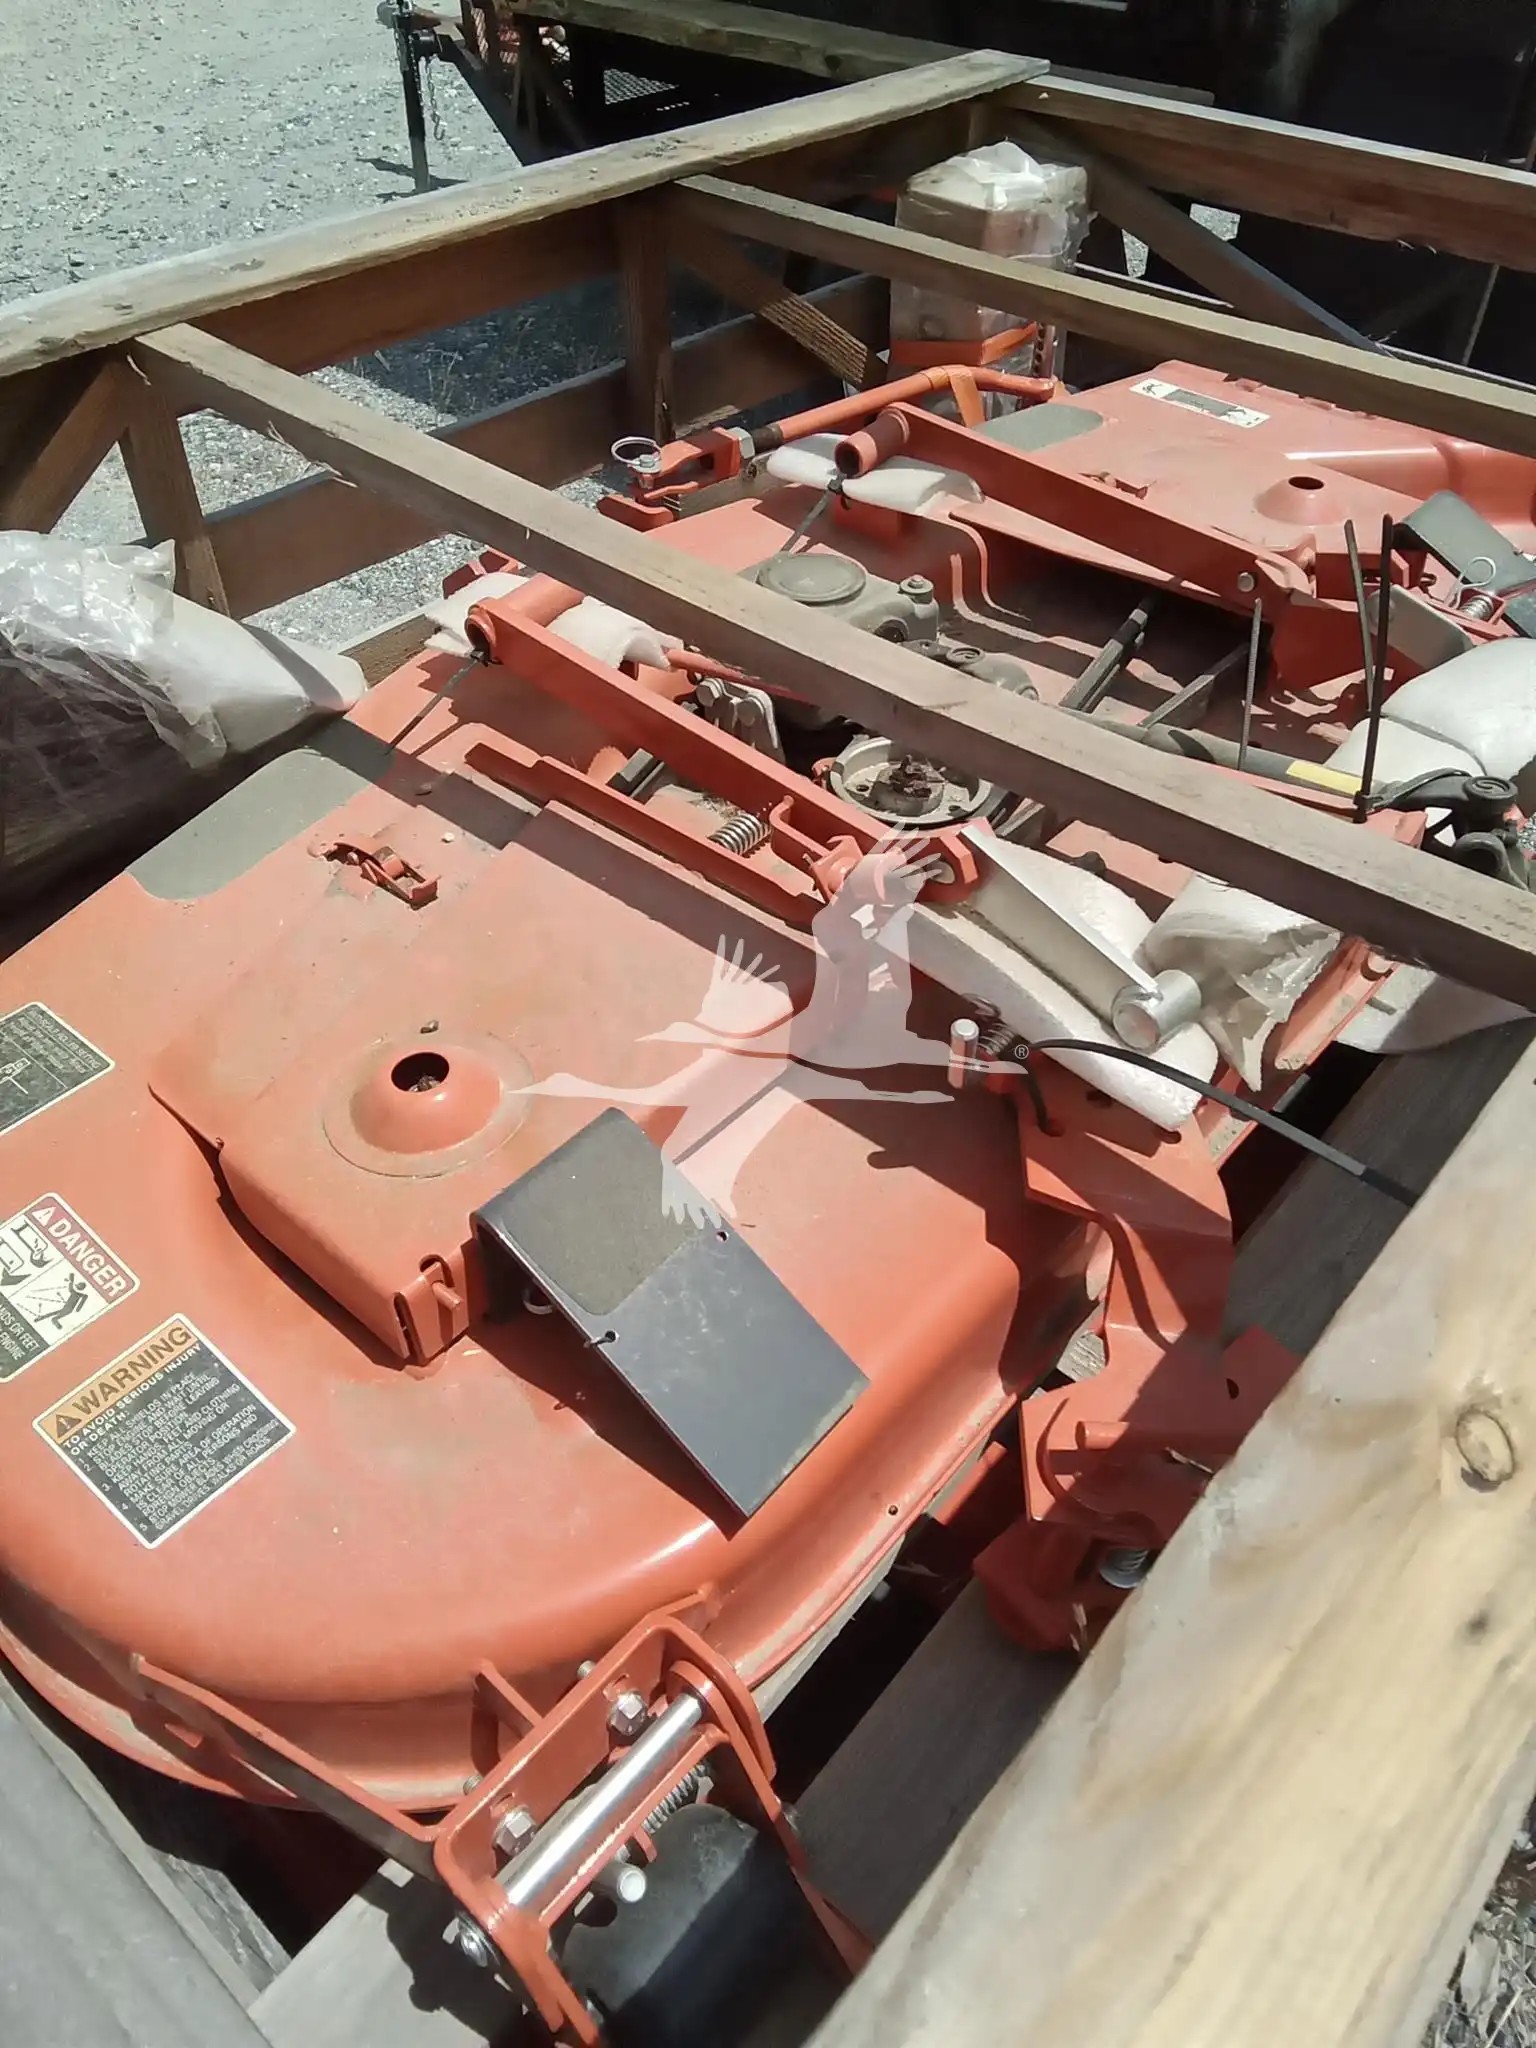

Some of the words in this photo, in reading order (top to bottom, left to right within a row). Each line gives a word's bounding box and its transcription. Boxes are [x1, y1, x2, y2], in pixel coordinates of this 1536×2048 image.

[48, 1218, 127, 1297] DANGER
[0, 1330, 26, 1361] ENGINE
[7, 1321, 26, 1337] OR
[17, 1331, 40, 1353] FEET
[70, 1323, 193, 1419] WARNING
[62, 1433, 81, 1450] TO
[80, 1405, 119, 1436] AVOID
[115, 1371, 164, 1410] SERIOUS
[162, 1342, 203, 1374] INJURY
[85, 1437, 111, 1458] KEEP
[107, 1424, 127, 1441] ALL
[124, 1398, 162, 1428] SHIELDS
[159, 1390, 173, 1402] IN
[91, 1442, 118, 1465] STOP
[115, 1419, 149, 1447] ENGINE
[145, 1405, 167, 1424] AND
[163, 1389, 188, 1410] WAIT
[184, 1372, 211, 1394] UNTIL
[98, 1442, 134, 1471] BLADES
[130, 1424, 157, 1446] STOP
[153, 1401, 187, 1429] BEFORE
[184, 1375, 221, 1405] LEAVING
[110, 1463, 135, 1485] KEEP
[182, 1410, 204, 1429] AND
[199, 1381, 242, 1416] CLOTHING
[68, 1439, 89, 1457] OR
[104, 1439, 151, 1478] OPERATOR
[116, 1467, 144, 1491] AWAY
[141, 1448, 169, 1472] FROM
[166, 1436, 185, 1452] ALL
[182, 1410, 218, 1440] MOVING
[214, 1400, 230, 1415] OR
[122, 1461, 166, 1498] ROTATING
[128, 1481, 156, 1504] MAKE
[153, 1462, 180, 1485] SURE
[176, 1444, 202, 1467] AREA
[198, 1436, 213, 1449] OF
[209, 1401, 257, 1441] OPERATION
[135, 1498, 148, 1511] IS
[144, 1476, 176, 1503] CLEAR
[172, 1467, 188, 1481] OF
[184, 1455, 204, 1472] ALL
[200, 1425, 242, 1460] PERSONS
[237, 1412, 259, 1431] AND
[147, 1503, 171, 1524] STOP
[167, 1481, 198, 1509] MOWER
[194, 1460, 225, 1487] BLADES
[221, 1444, 245, 1465] WHEN
[241, 1417, 280, 1450] CROSSING
[141, 1484, 180, 1517] FOREIGN
[153, 1503, 186, 1531] GRAVEL
[209, 1462, 237, 1486] WALKS
[233, 1453, 248, 1467] OR
